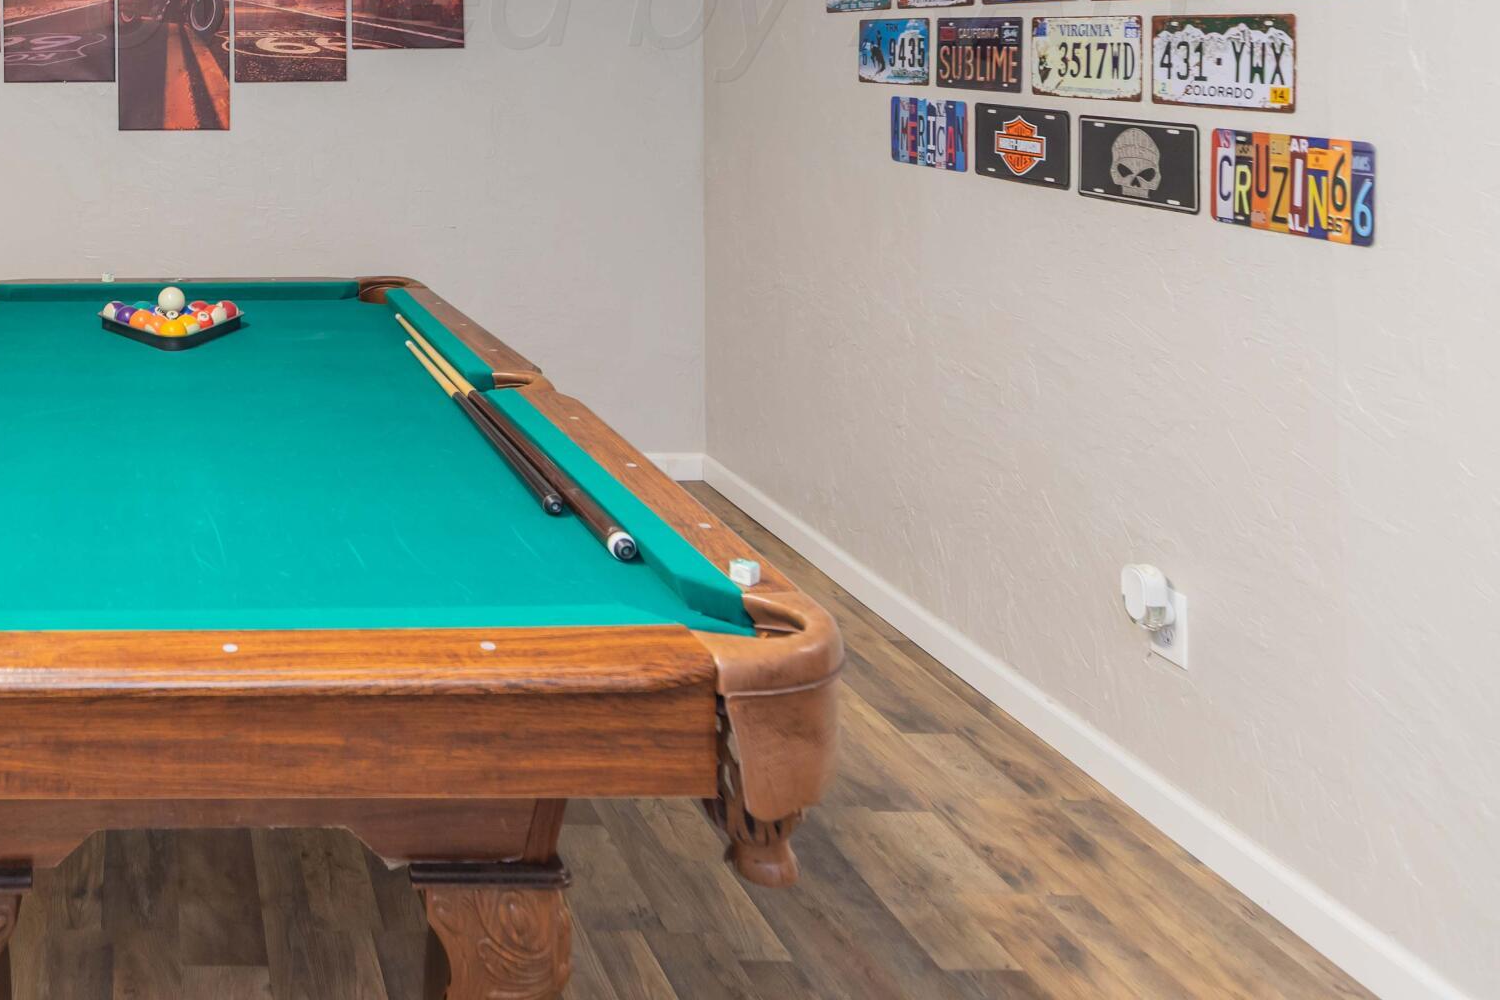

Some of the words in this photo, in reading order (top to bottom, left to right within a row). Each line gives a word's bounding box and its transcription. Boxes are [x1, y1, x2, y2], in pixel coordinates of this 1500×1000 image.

[957, 26, 1000, 40] CALIFORNIA
[1059, 24, 1113, 38] VIRGINIA
[889, 36, 925, 67] 9435
[939, 44, 1018, 84] SUBLIME
[1057, 42, 1135, 81] 3517WD
[1185, 83, 1254, 100] COLORADO
[892, 104, 965, 163] AMERICAN
